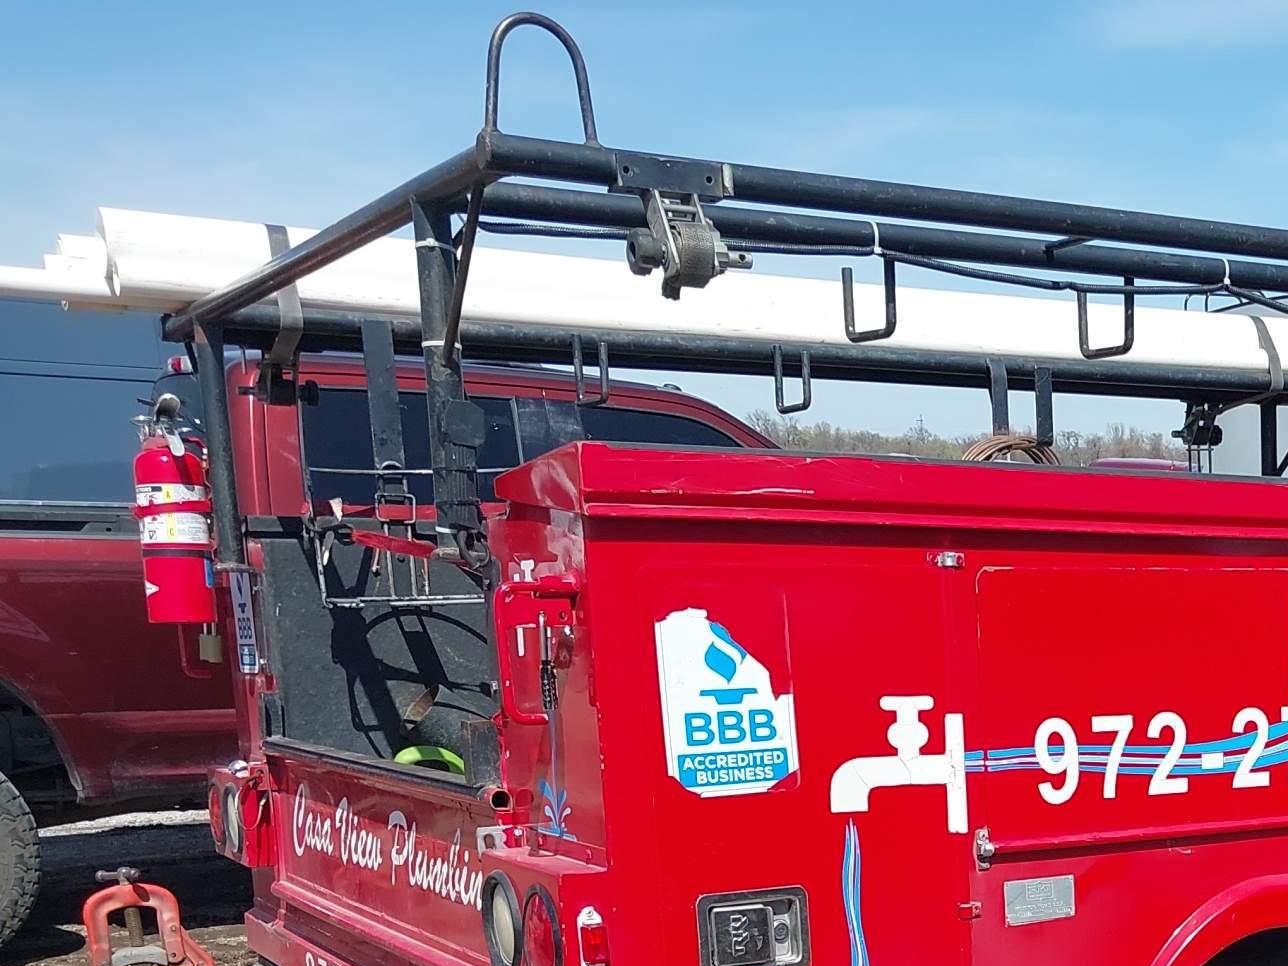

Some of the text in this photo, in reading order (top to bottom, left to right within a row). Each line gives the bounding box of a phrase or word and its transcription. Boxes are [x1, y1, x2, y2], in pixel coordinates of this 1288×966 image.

[685, 709, 777, 746] BBB
[683, 750, 784, 770] ACCREDITED
[696, 766, 774, 784] BUSINESS
[293, 784, 483, 911] Casa View Plumbin
